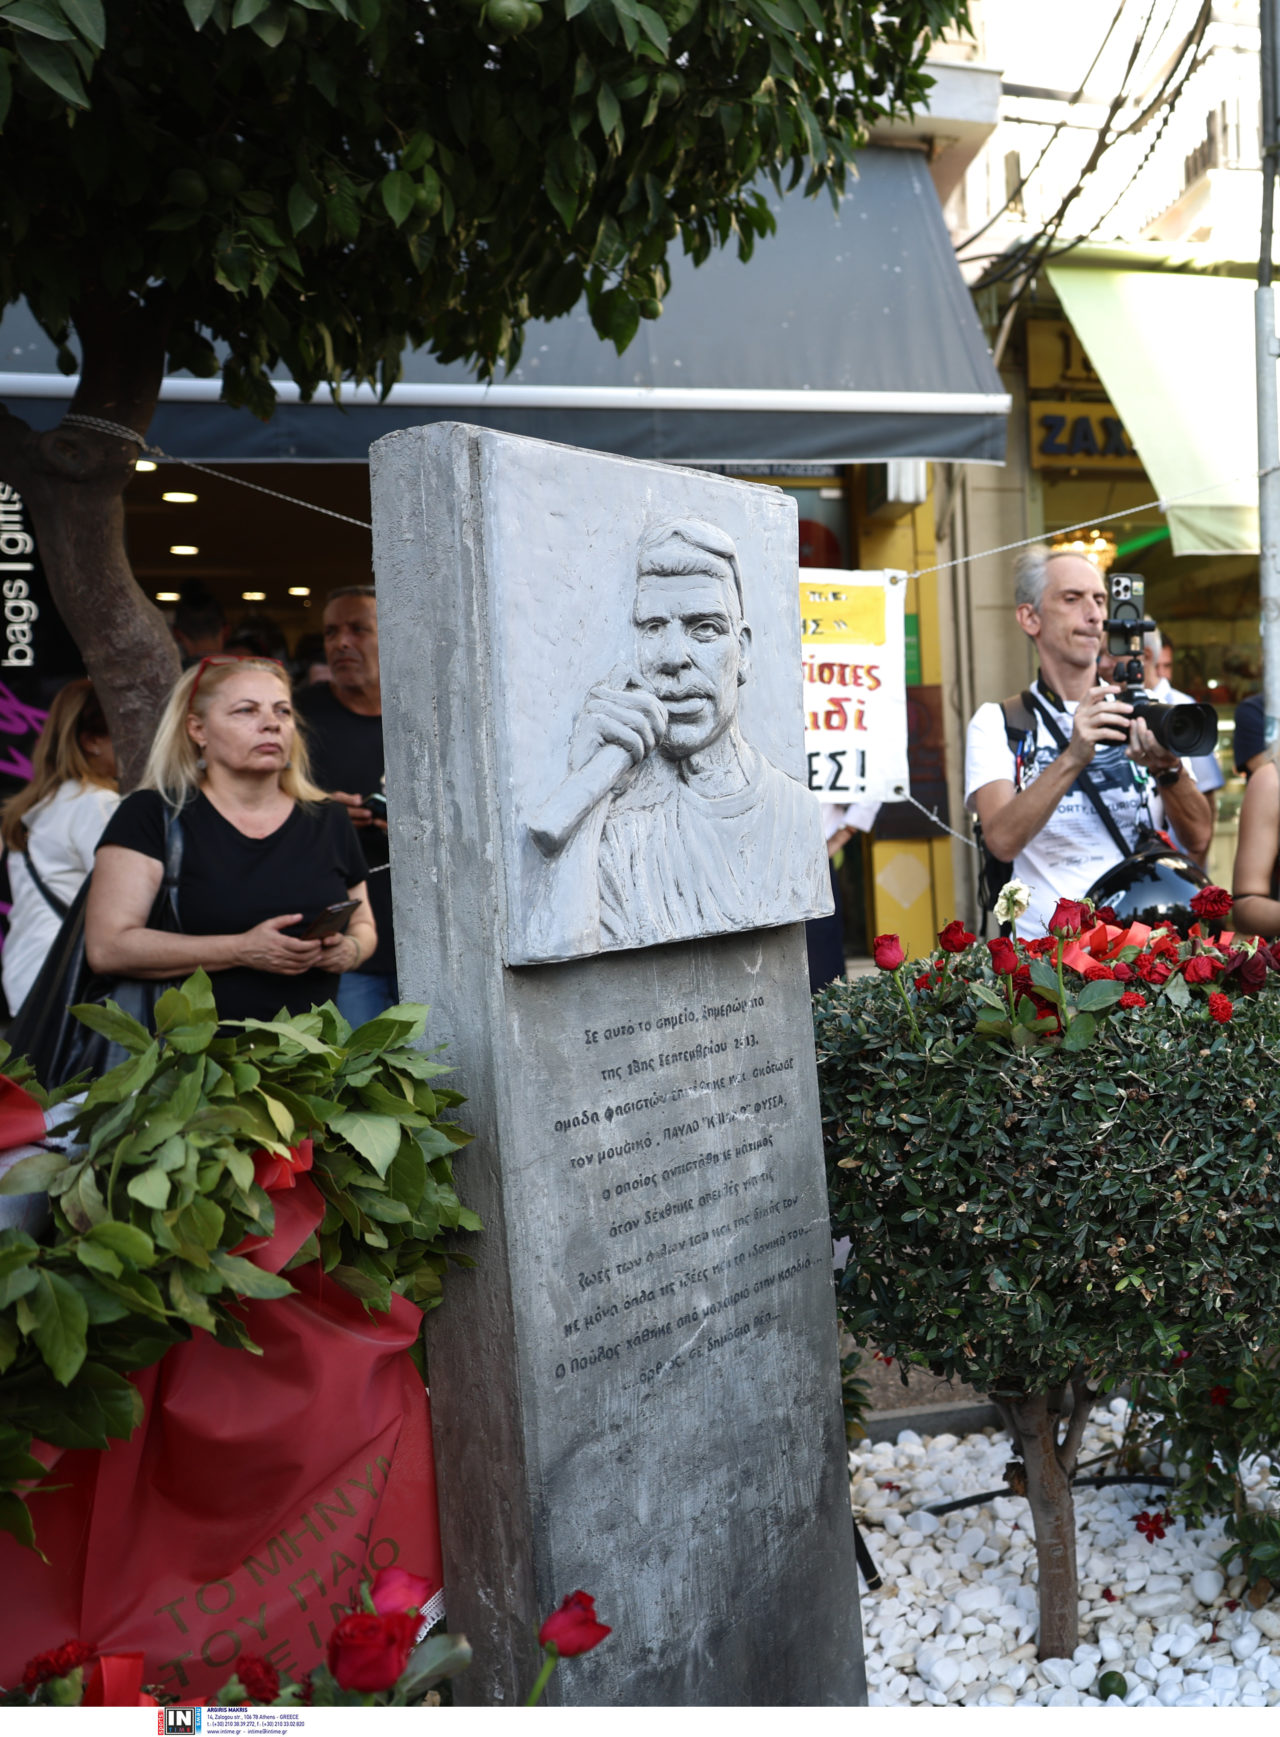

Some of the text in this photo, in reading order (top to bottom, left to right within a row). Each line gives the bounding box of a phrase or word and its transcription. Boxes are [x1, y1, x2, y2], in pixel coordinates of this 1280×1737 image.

[1039, 414, 1137, 457] ΖΑΧ
[1, 579, 39, 666] bags
[584, 1029, 599, 1045] Σε
[604, 1019, 635, 1041] αυτό
[638, 1021, 652, 1032] το
[601, 1066, 622, 1081] της
[570, 1152, 594, 1168] τον
[615, 1173, 658, 1196] οποίος
